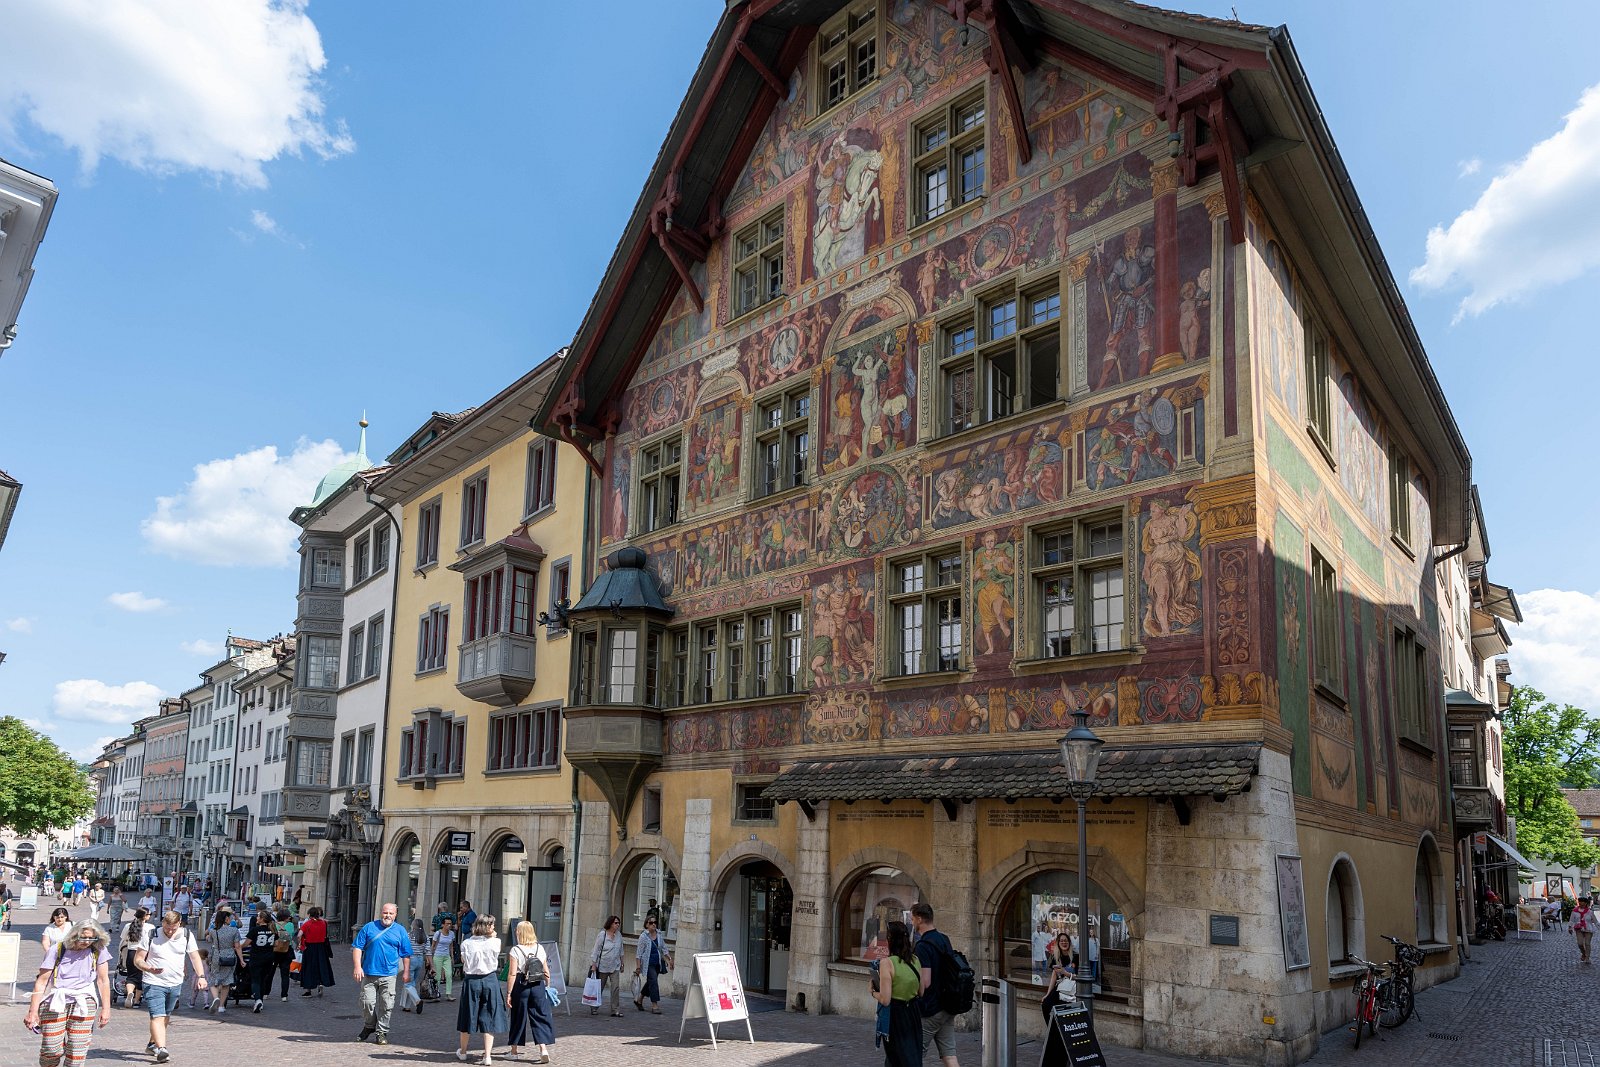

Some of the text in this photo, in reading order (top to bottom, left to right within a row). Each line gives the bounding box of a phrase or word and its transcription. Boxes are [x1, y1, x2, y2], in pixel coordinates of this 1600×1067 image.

[836, 705, 857, 718] Ritter
[456, 856, 470, 864] JONE
[1032, 911, 1101, 926] UMGEZOEN
[256, 934, 275, 946] 84
